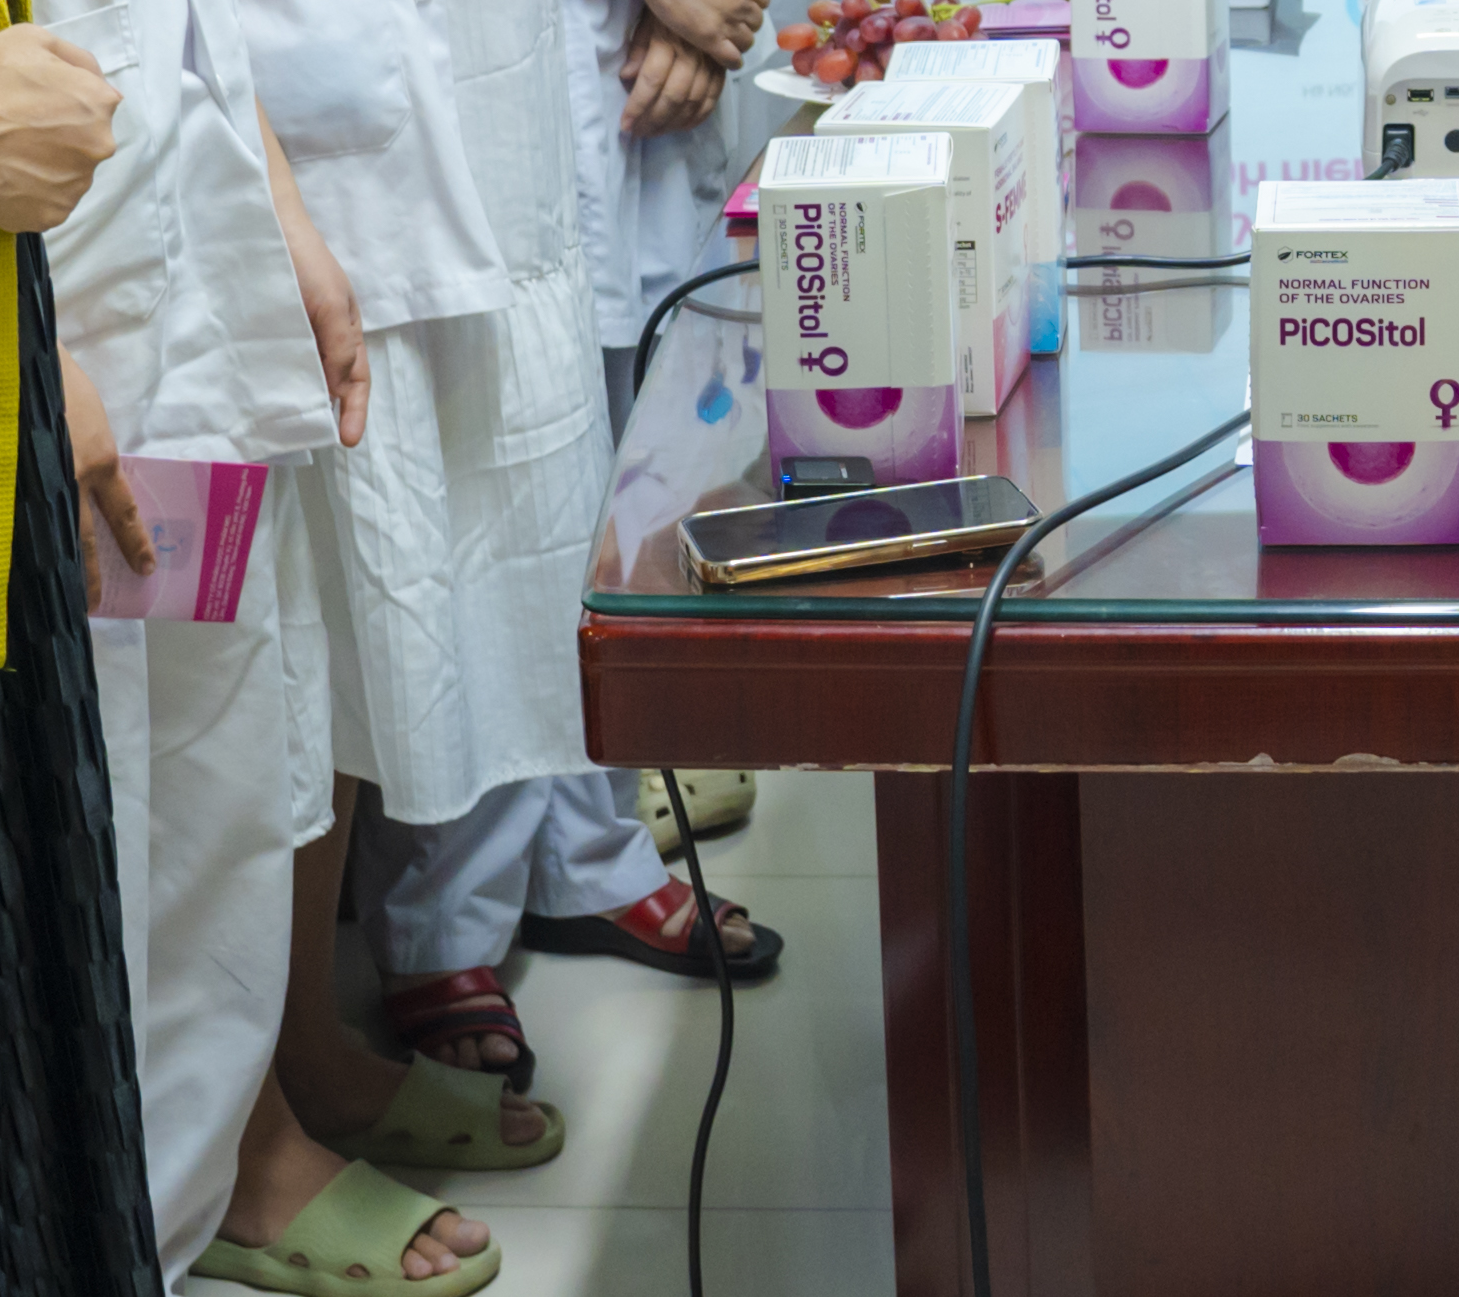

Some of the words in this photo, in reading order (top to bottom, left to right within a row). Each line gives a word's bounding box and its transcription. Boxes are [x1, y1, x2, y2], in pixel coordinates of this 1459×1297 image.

[828, 203, 836, 217] OF
[839, 202, 848, 248] NORMAL
[857, 215, 867, 255] FORTEX
[830, 242, 839, 286] OVARIES
[1296, 250, 1348, 259] FORTEX
[794, 203, 829, 338] PiCOSitol
[841, 251, 851, 303] FUNCTION
[1279, 279, 1346, 289] NORMAL
[1351, 279, 1430, 289] FUNCTION
[1279, 293, 1300, 304] OF
[1304, 293, 1334, 304] THE
[1339, 293, 1405, 304] OVARIES
[1279, 317, 1425, 347] PiCOSitol
[1297, 414, 1310, 423] 30
[1312, 414, 1358, 423] SACHETS
